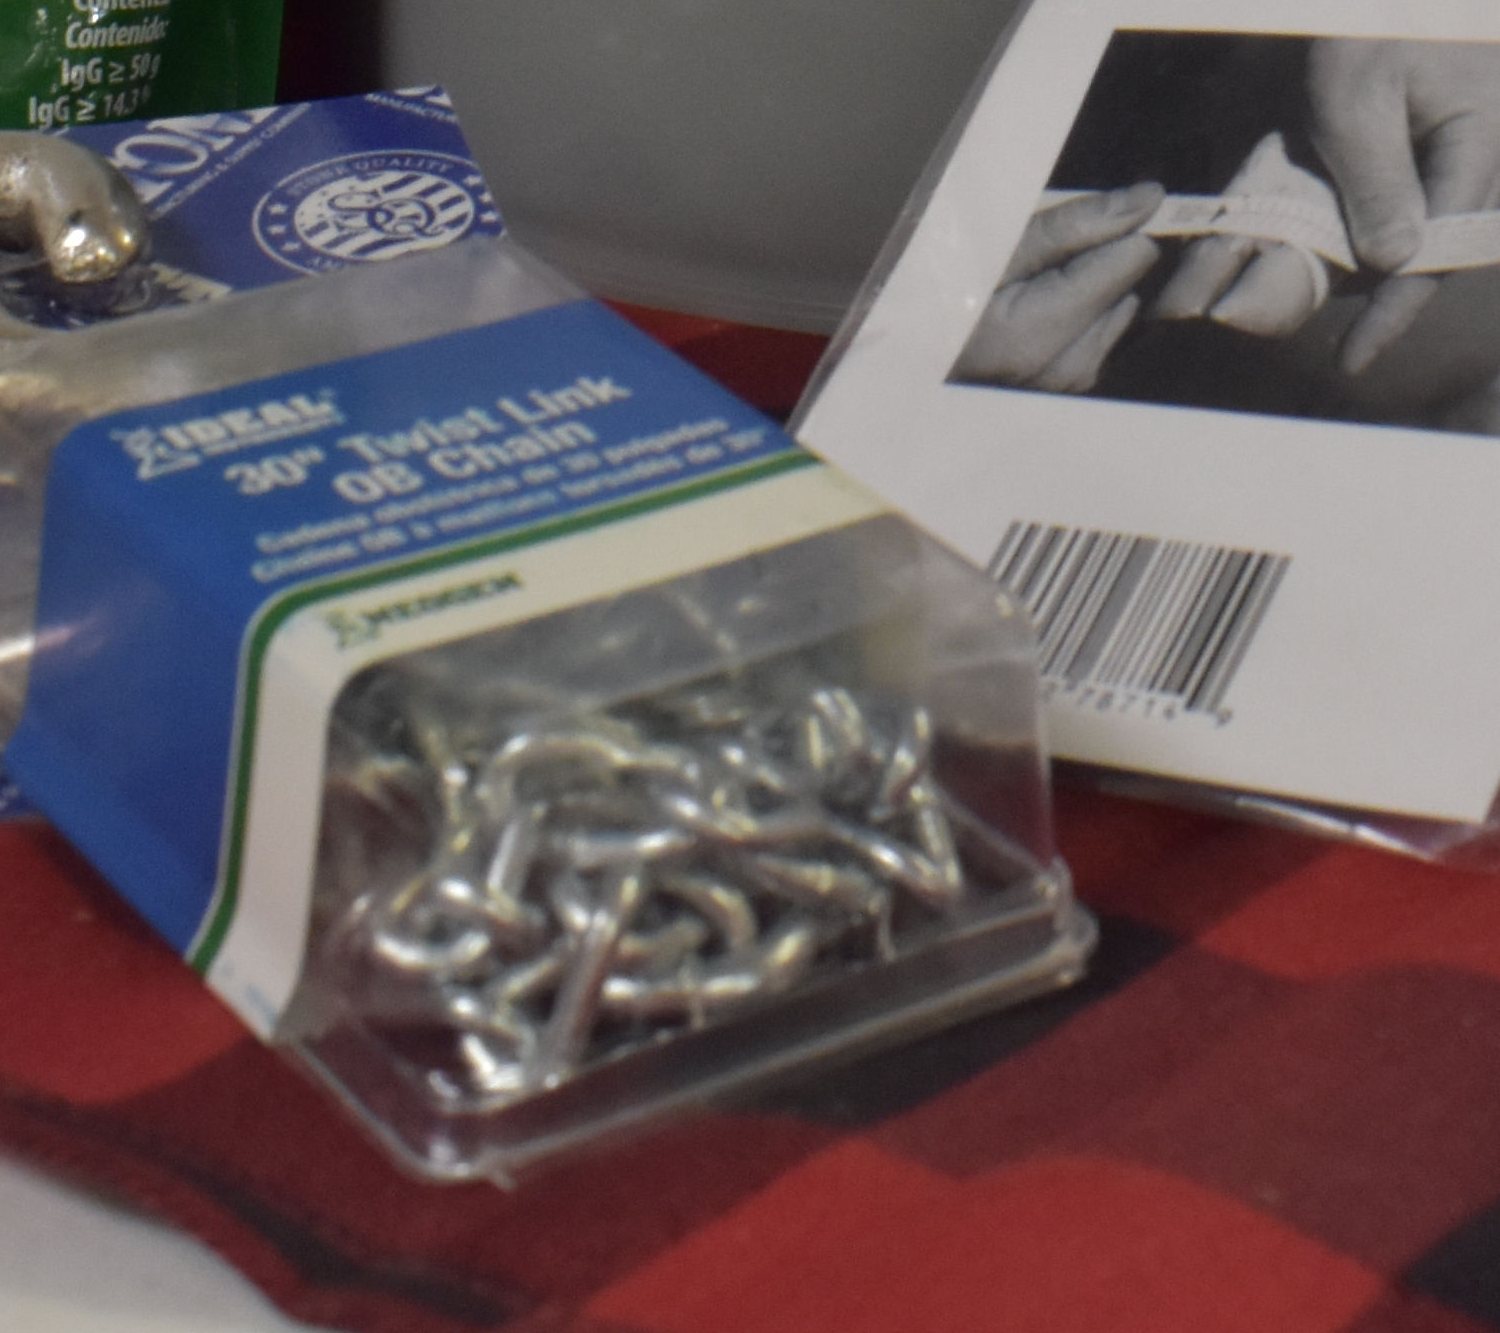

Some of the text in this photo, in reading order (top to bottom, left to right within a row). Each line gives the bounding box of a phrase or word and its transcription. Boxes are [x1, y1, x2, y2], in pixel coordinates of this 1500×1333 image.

[61, 58, 102, 90] IgG
[28, 97, 69, 129] IgG
[338, 407, 503, 464] Twist
[498, 376, 632, 426] Link
[333, 462, 424, 504] OB
[428, 420, 598, 481] Chain
